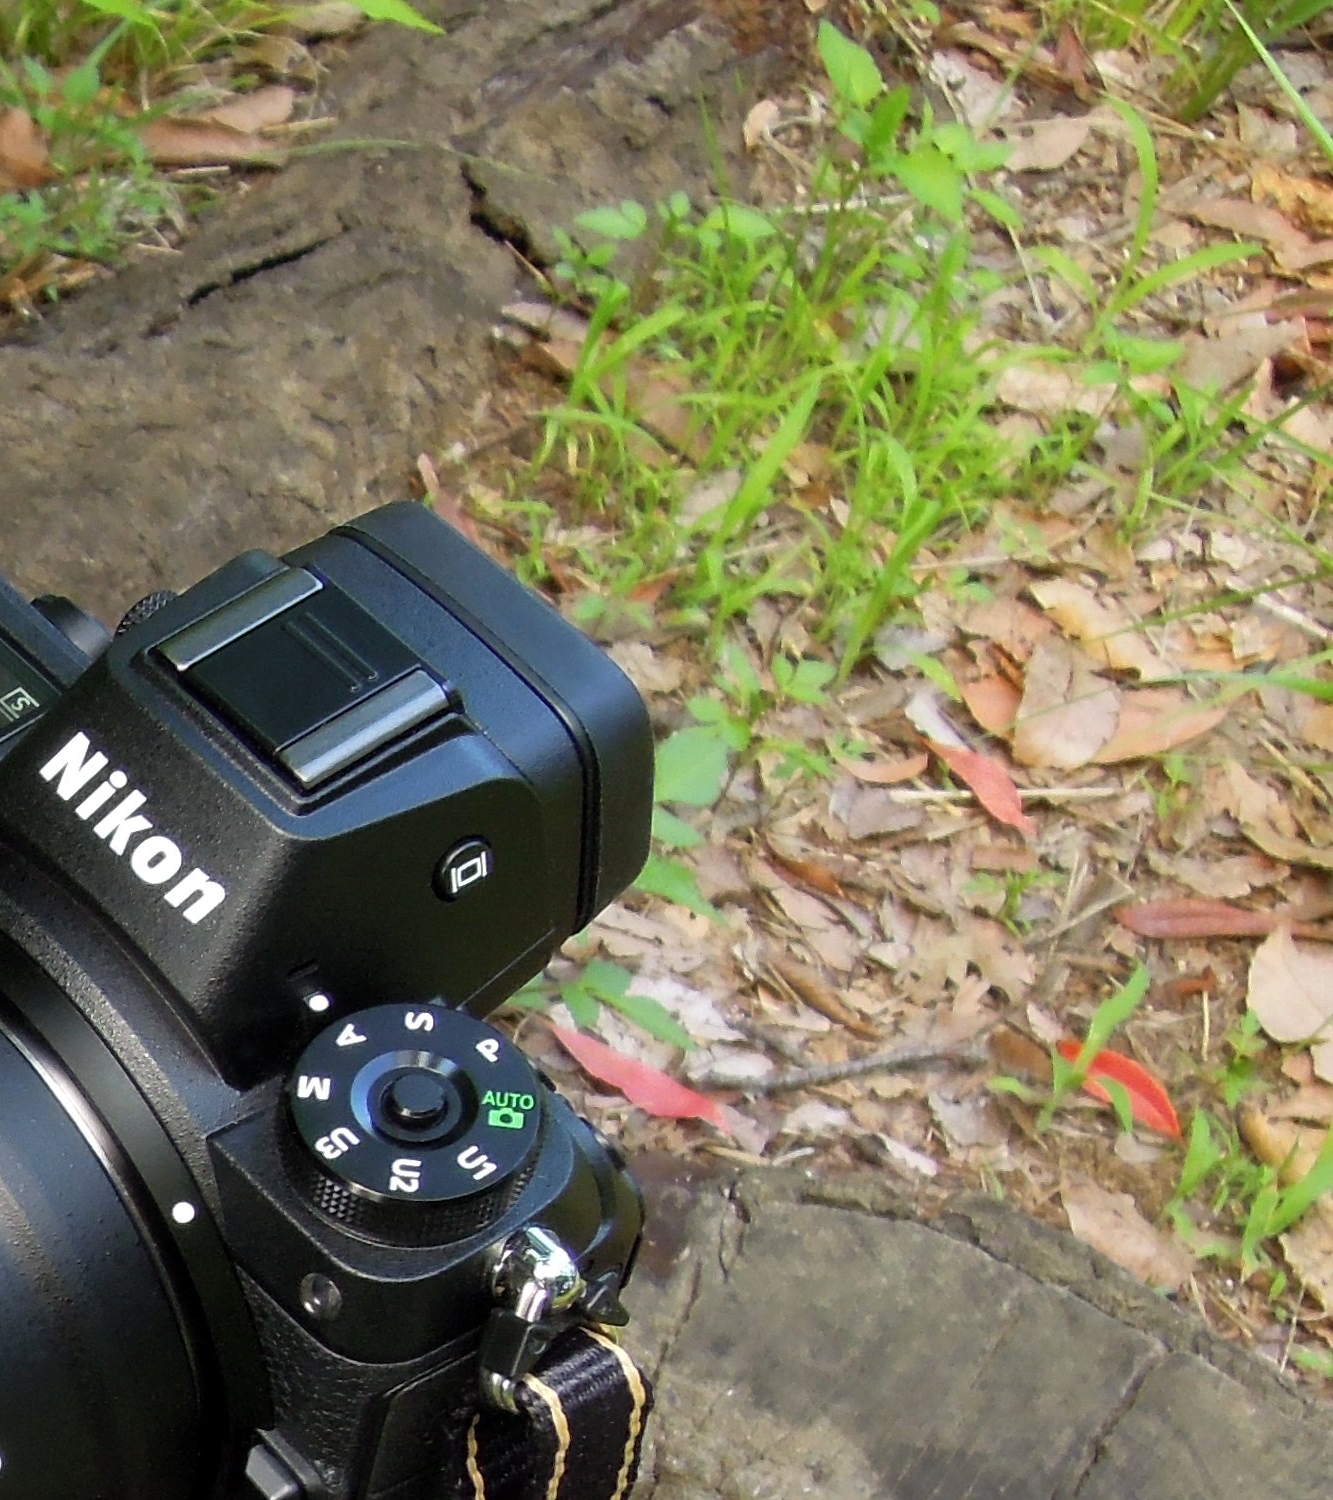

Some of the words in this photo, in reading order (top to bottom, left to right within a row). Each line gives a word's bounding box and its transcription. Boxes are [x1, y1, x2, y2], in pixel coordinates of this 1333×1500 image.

[39, 731, 226, 925] Nikon
[404, 1011, 434, 1032] S
[335, 1023, 367, 1048] A
[475, 1038, 500, 1063] P
[297, 1076, 331, 1101] M
[482, 1091, 534, 1111] AUTO
[315, 1127, 361, 1160] U3
[456, 1145, 497, 1180] U1
[389, 1158, 421, 1193] U2
